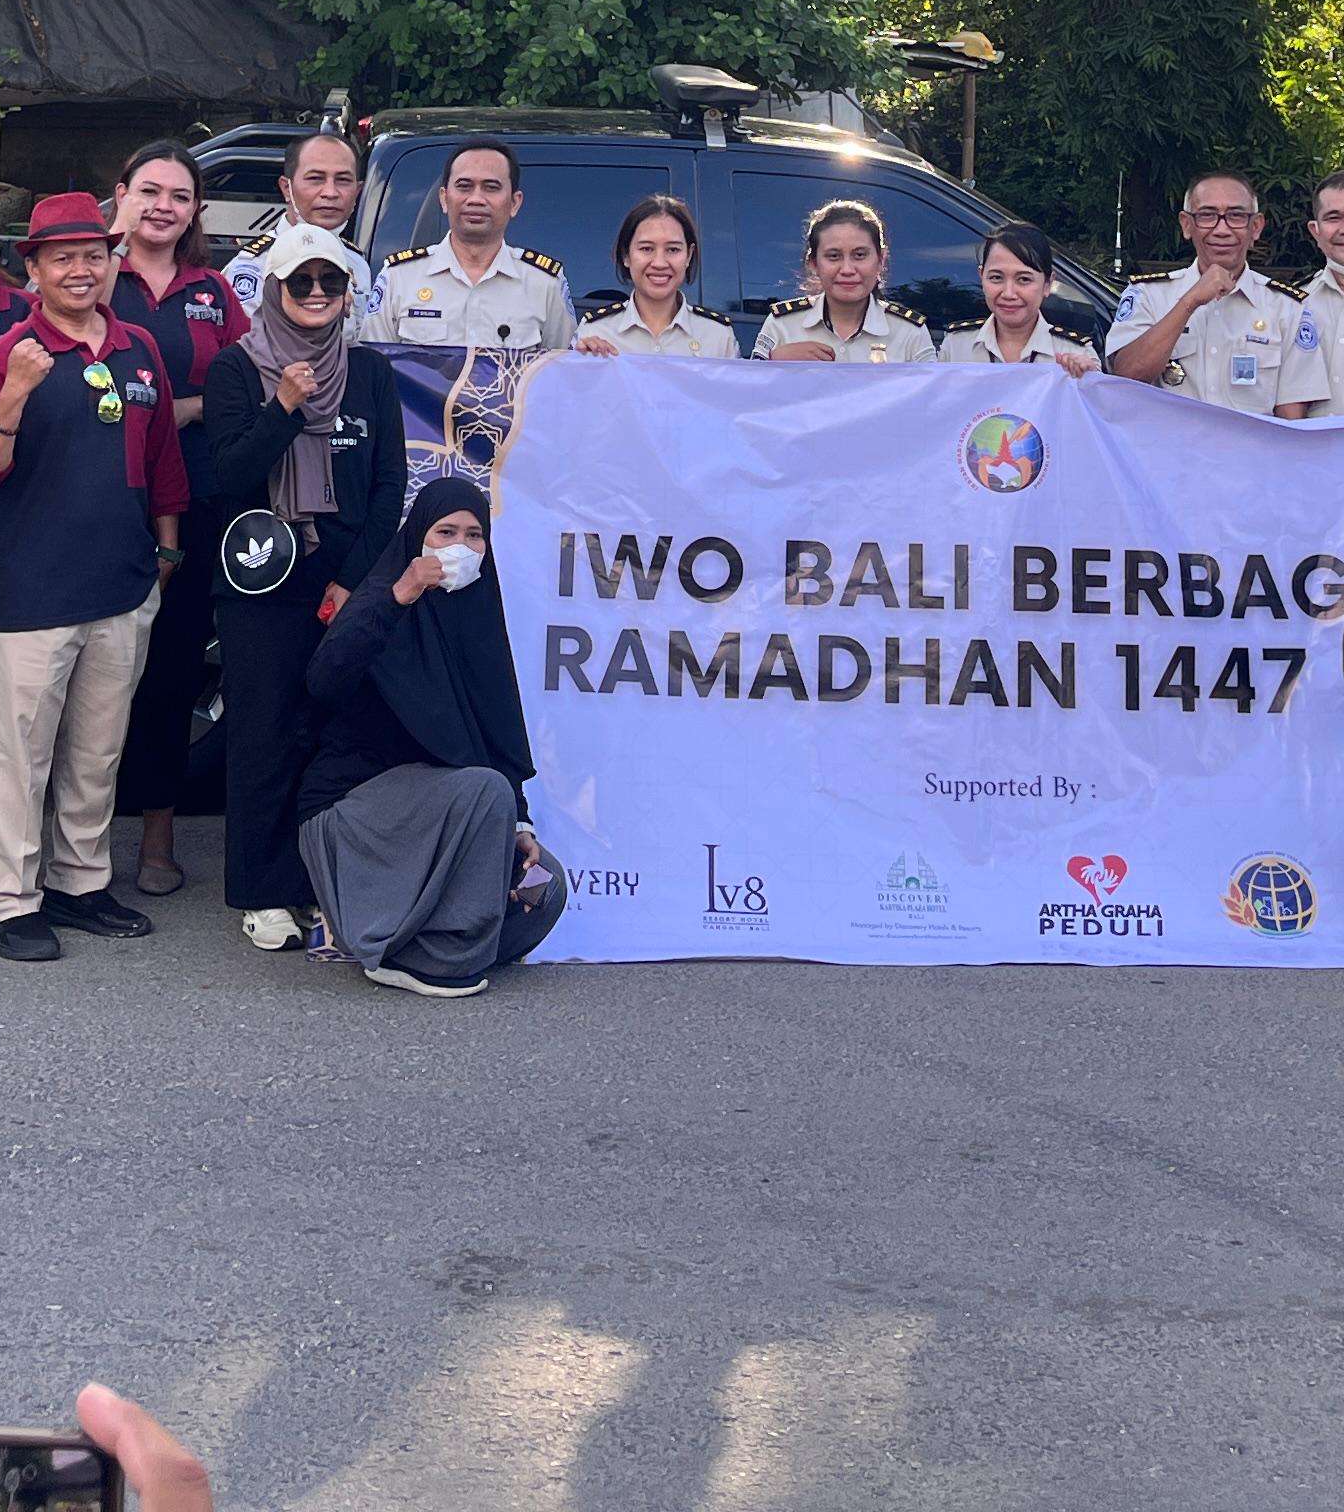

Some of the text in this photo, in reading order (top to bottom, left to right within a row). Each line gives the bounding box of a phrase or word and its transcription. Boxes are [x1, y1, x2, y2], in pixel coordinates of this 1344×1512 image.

[558, 532, 744, 604] IWO
[784, 539, 970, 610] BALI
[544, 624, 1306, 714] RAMADHAN 1447
[924, 772, 1043, 802] Supported
[1052, 775, 1082, 804] By
[567, 868, 639, 896] VERY
[877, 893, 950, 903] DISCOVERY
[1039, 903, 1162, 918] ARTHA GRAHA
[1039, 918, 1163, 936] PEDULI
